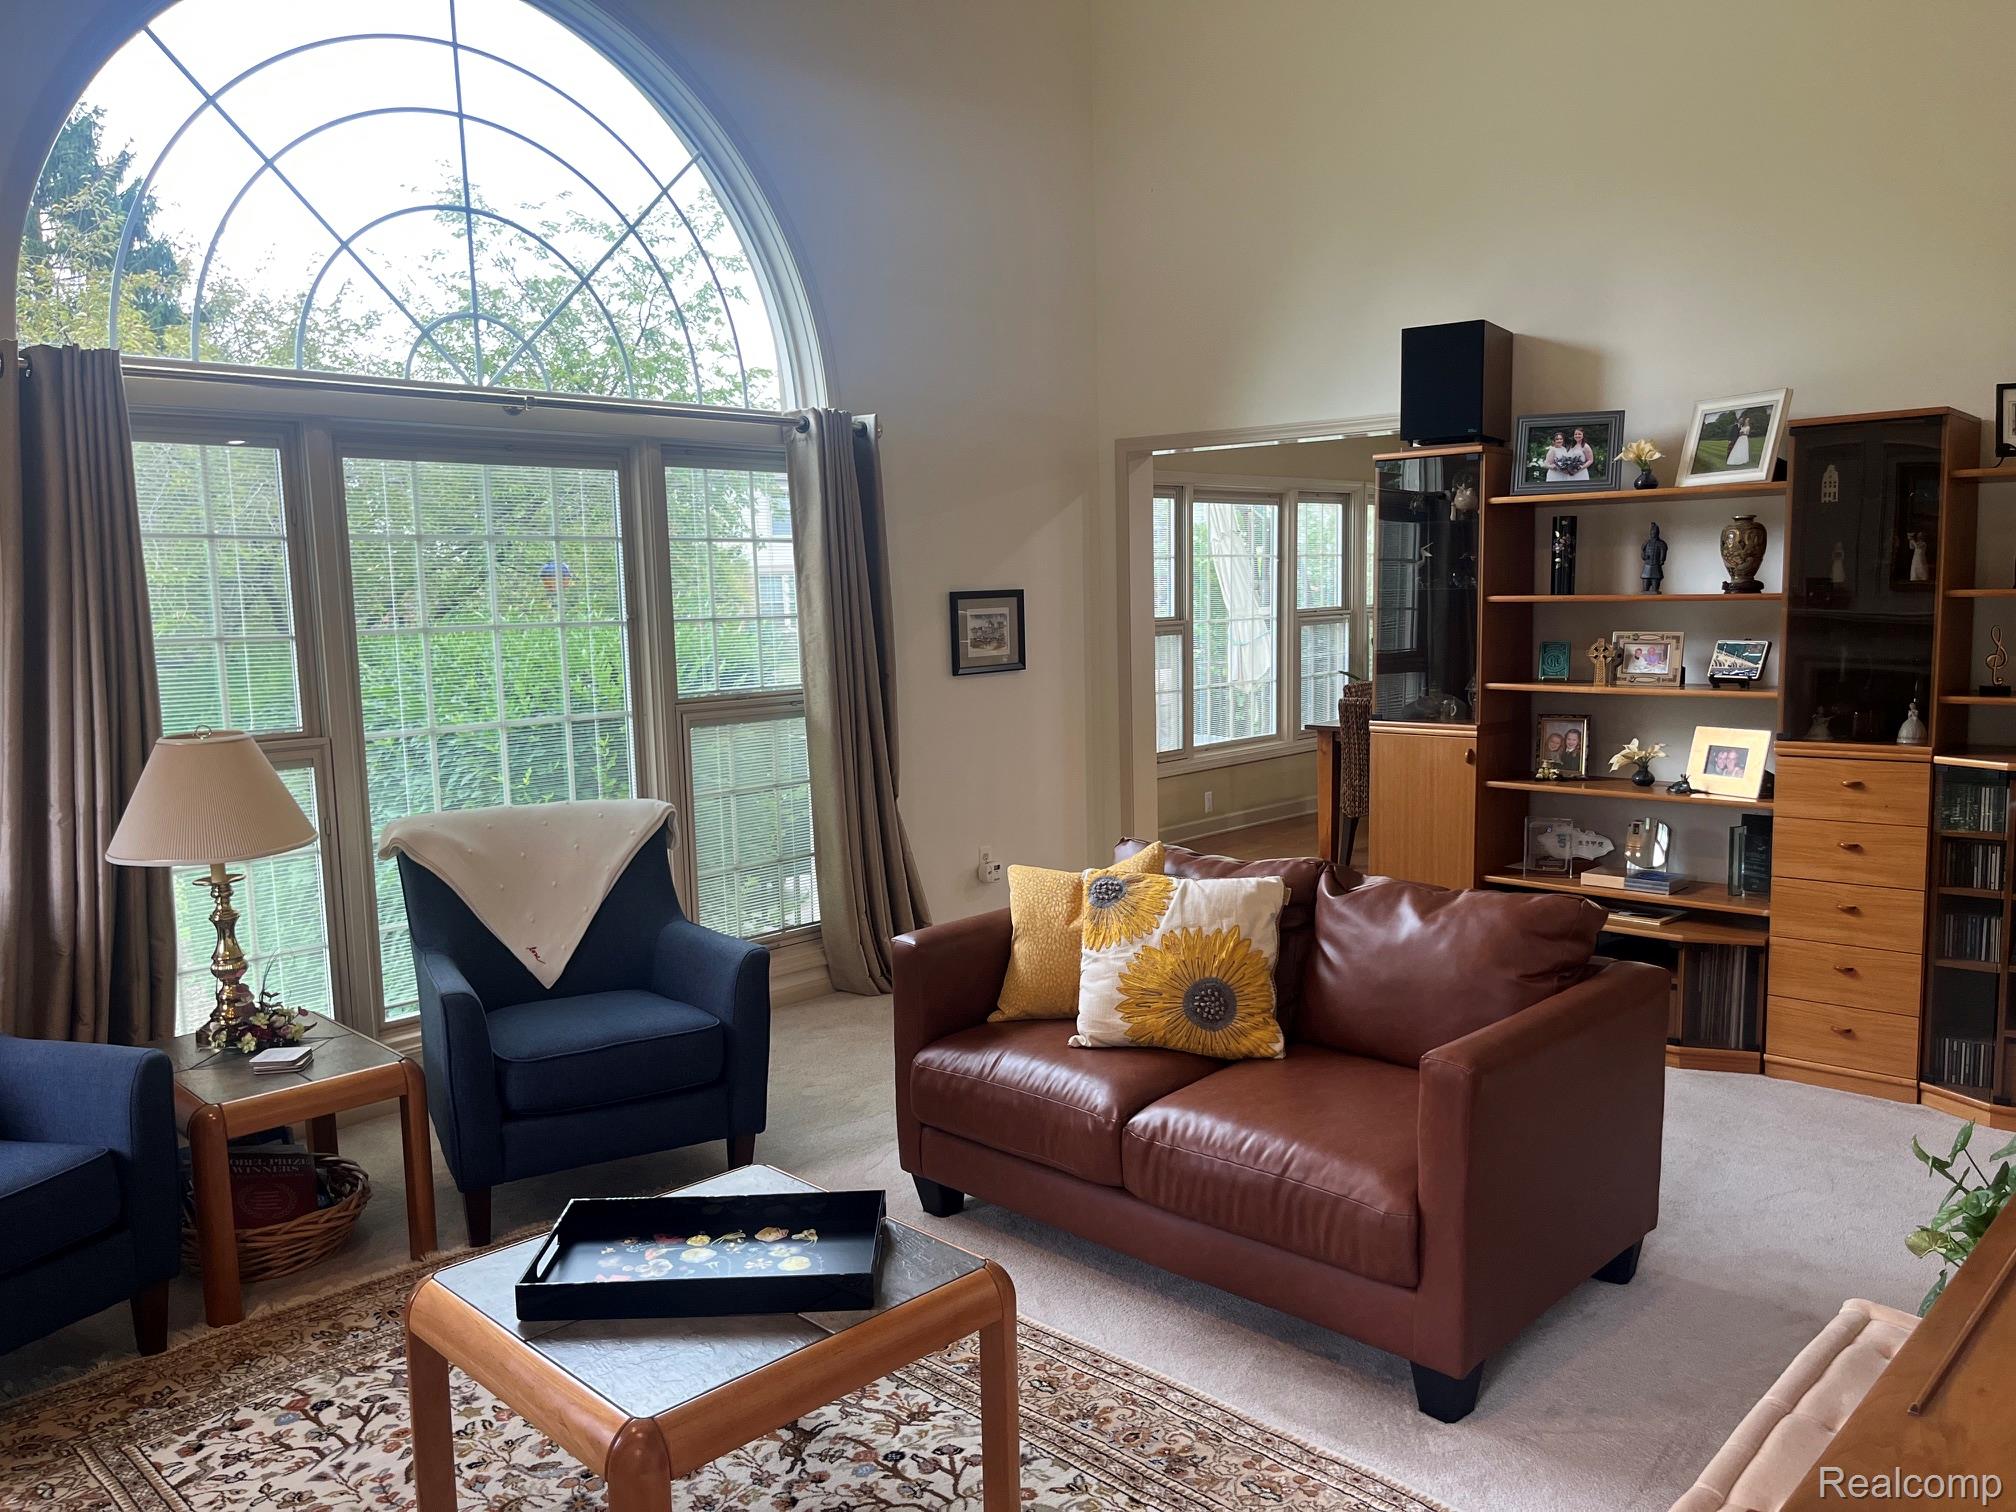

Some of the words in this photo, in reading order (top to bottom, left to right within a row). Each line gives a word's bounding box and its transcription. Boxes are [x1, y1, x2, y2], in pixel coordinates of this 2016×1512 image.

[229, 1158, 266, 1166] OBEL
[270, 1158, 311, 1166] PRIZE
[232, 1166, 299, 1174] WINNERS
